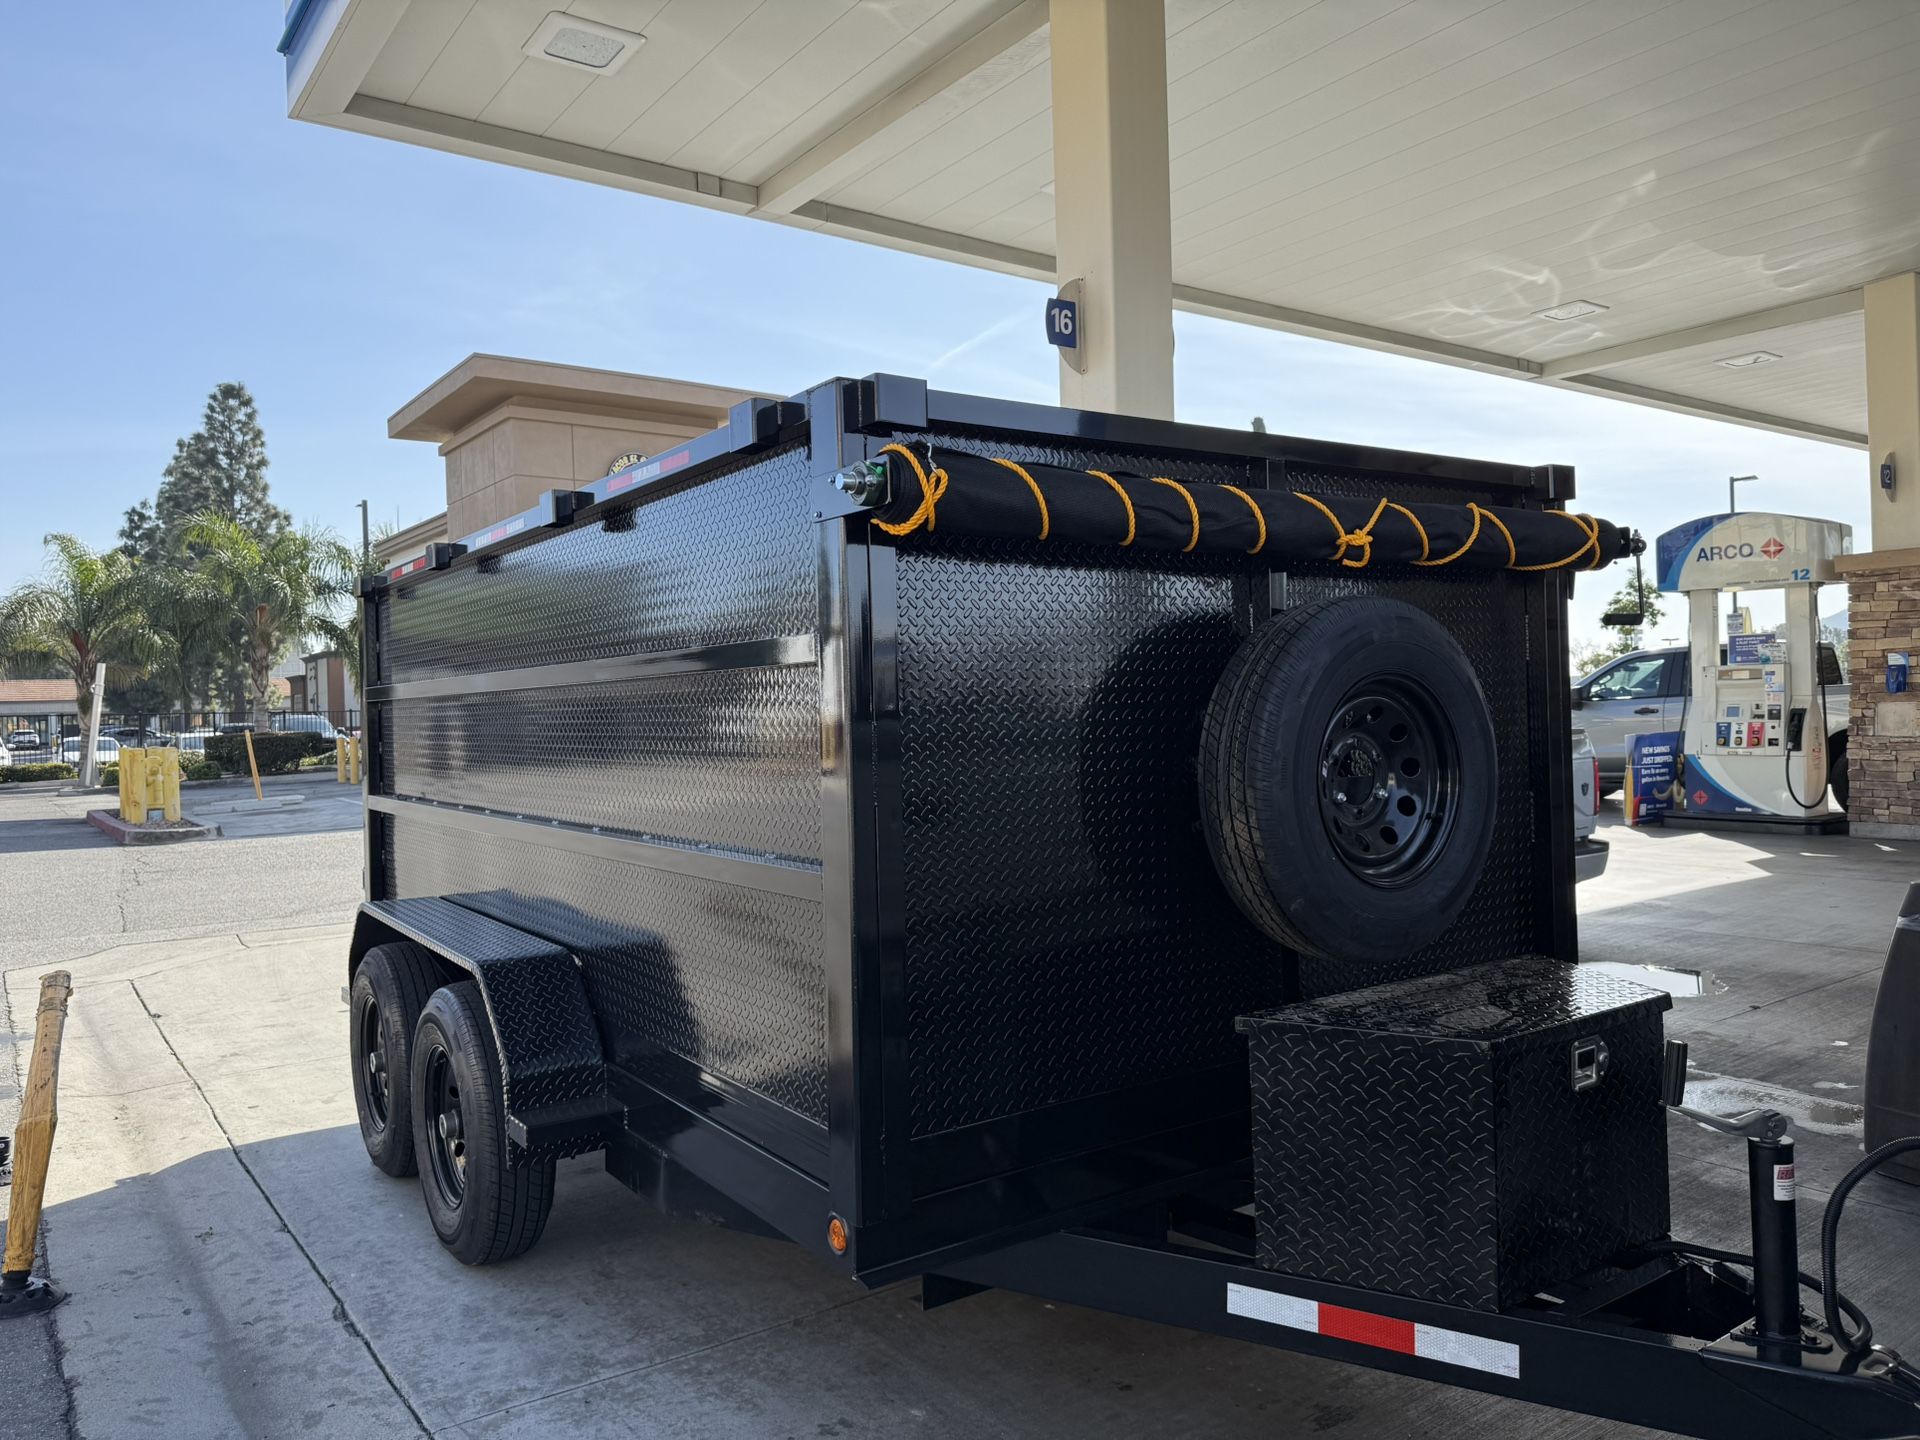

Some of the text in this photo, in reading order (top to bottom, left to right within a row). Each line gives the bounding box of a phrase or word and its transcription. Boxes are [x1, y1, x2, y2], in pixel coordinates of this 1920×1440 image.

[1050, 307, 1073, 335] 16
[1696, 543, 1754, 562] ARCO
[1791, 568, 1810, 581] 12
[1642, 746, 1654, 754] NEW
